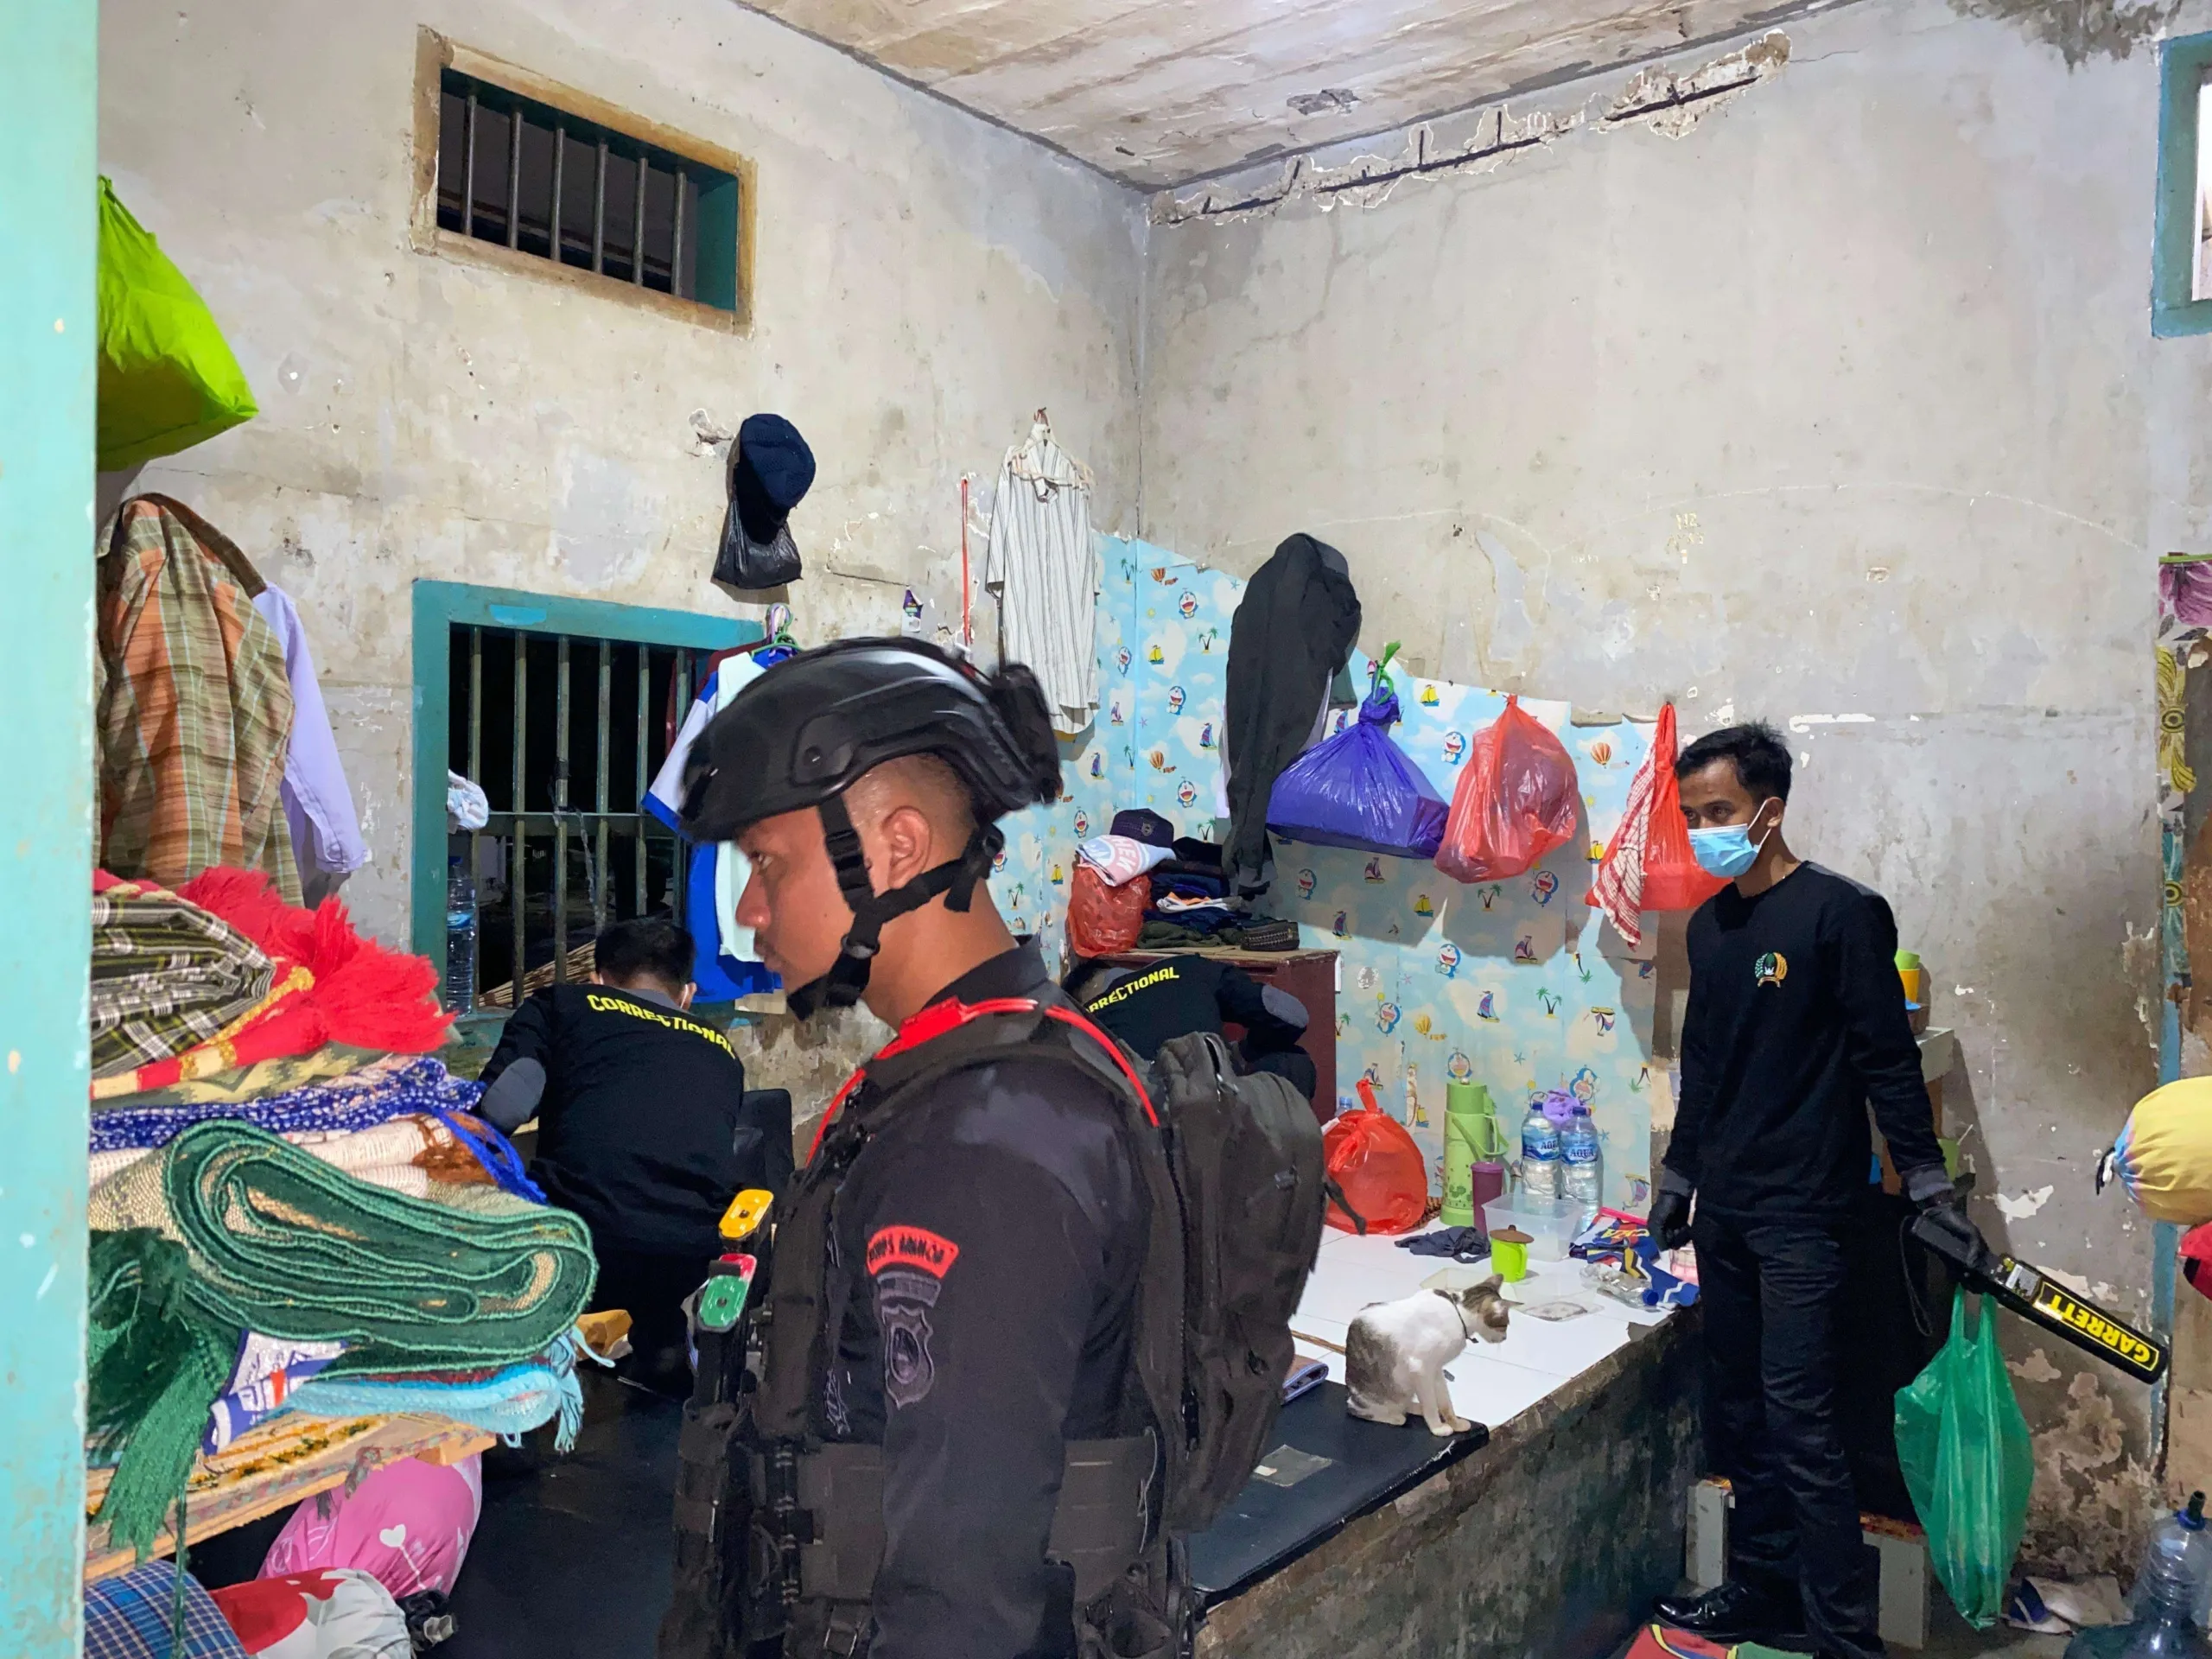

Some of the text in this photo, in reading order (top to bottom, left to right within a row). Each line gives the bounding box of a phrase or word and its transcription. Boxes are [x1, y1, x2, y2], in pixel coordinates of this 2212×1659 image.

[1085, 966, 1180, 1014] RRECTIONAL
[586, 995, 736, 1060] CORRECTIONAL
[1570, 1148, 1594, 1159] AQUA
[2046, 1294, 2152, 1363] GARRETT
